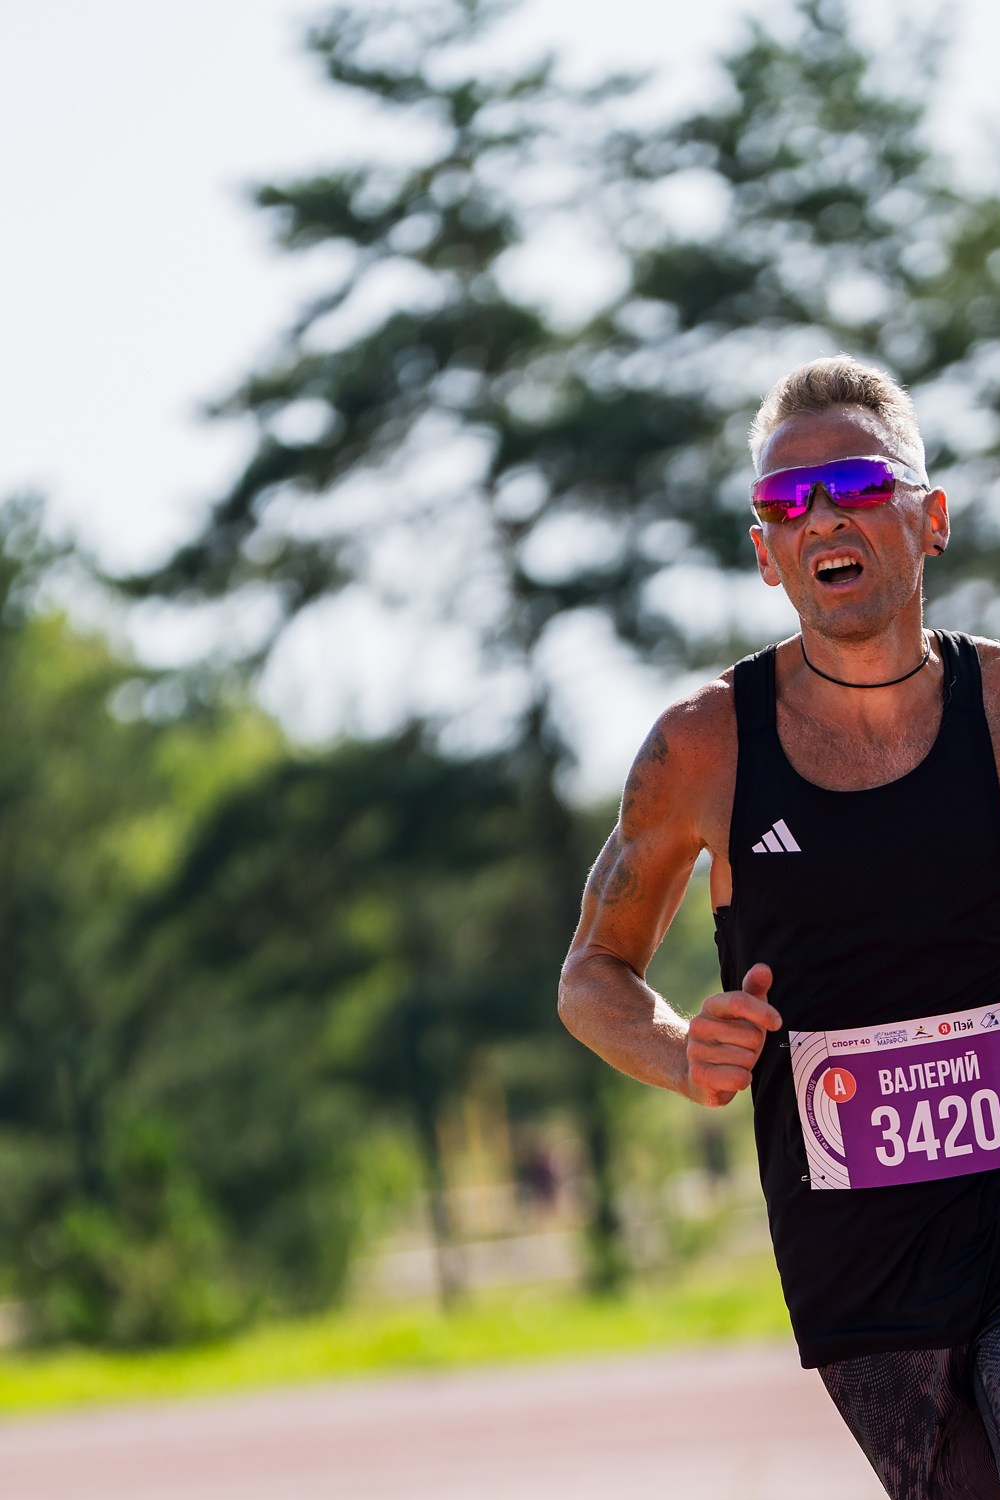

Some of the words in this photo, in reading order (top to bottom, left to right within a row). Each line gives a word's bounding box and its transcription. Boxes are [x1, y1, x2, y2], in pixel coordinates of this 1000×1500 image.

[953, 1018, 974, 1032] Пэй
[832, 1039, 858, 1048] СПОРТ
[878, 1050, 981, 1096] ВАЛЕРИЙ
[834, 1074, 846, 1096] А
